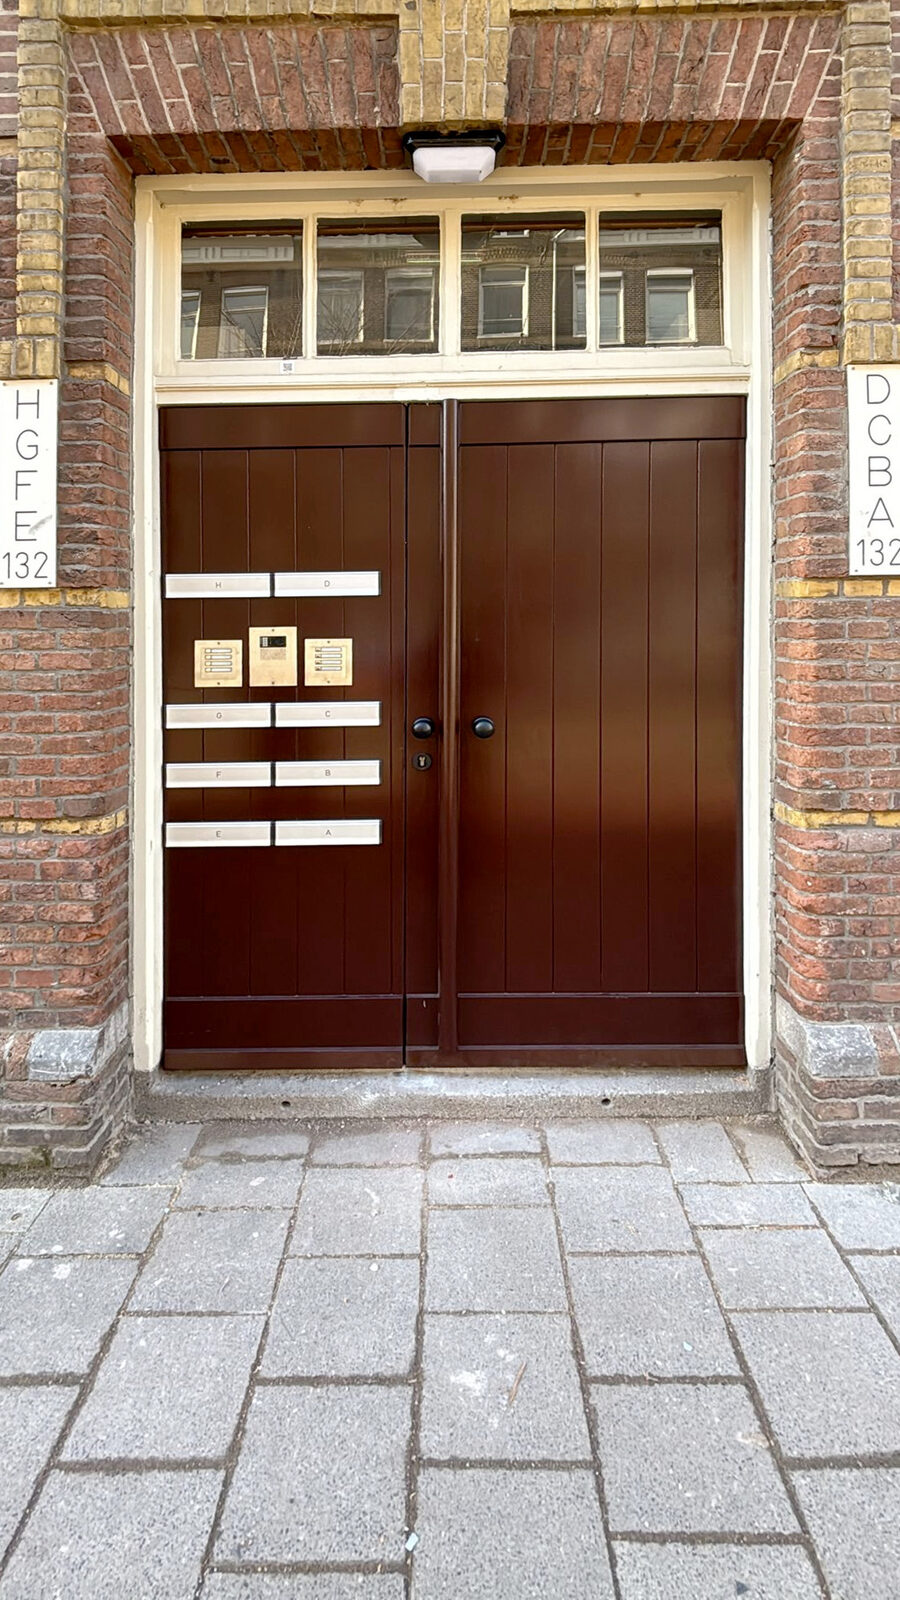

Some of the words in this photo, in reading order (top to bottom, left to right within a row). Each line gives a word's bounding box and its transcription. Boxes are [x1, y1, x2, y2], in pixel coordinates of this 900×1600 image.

[16, 389, 39, 419] H
[867, 374, 890, 404] D
[16, 429, 39, 460] G
[868, 414, 892, 446] C
[15, 470, 38, 500] F
[868, 456, 892, 486] B
[15, 510, 37, 541] E
[867, 497, 894, 528] A
[2, 551, 48, 579] 132
[856, 538, 900, 566] 132
[325, 710, 331, 718] C
[216, 830, 222, 838] E
